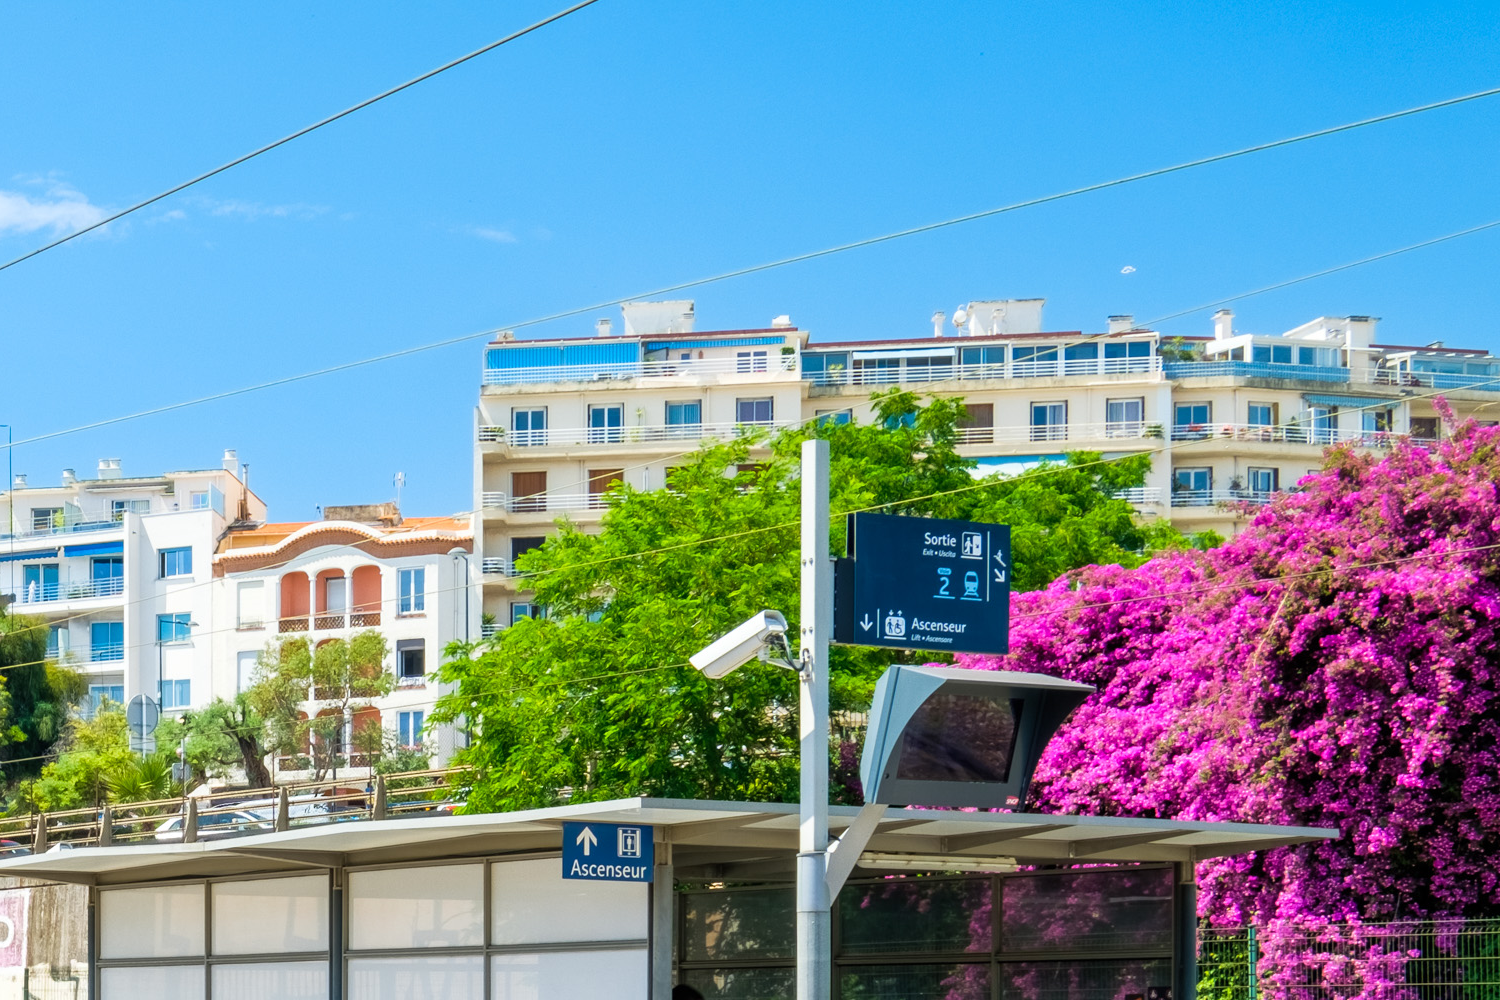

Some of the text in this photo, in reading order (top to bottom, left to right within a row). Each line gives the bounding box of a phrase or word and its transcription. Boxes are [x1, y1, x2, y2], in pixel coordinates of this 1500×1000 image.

[924, 532, 957, 547] Sortie
[922, 548, 957, 558] Exit Uscita
[939, 576, 950, 595] 2
[911, 617, 967, 633] Ascenseur
[911, 633, 953, 643] Lift Ascensore
[570, 858, 647, 879] Ascenseur
